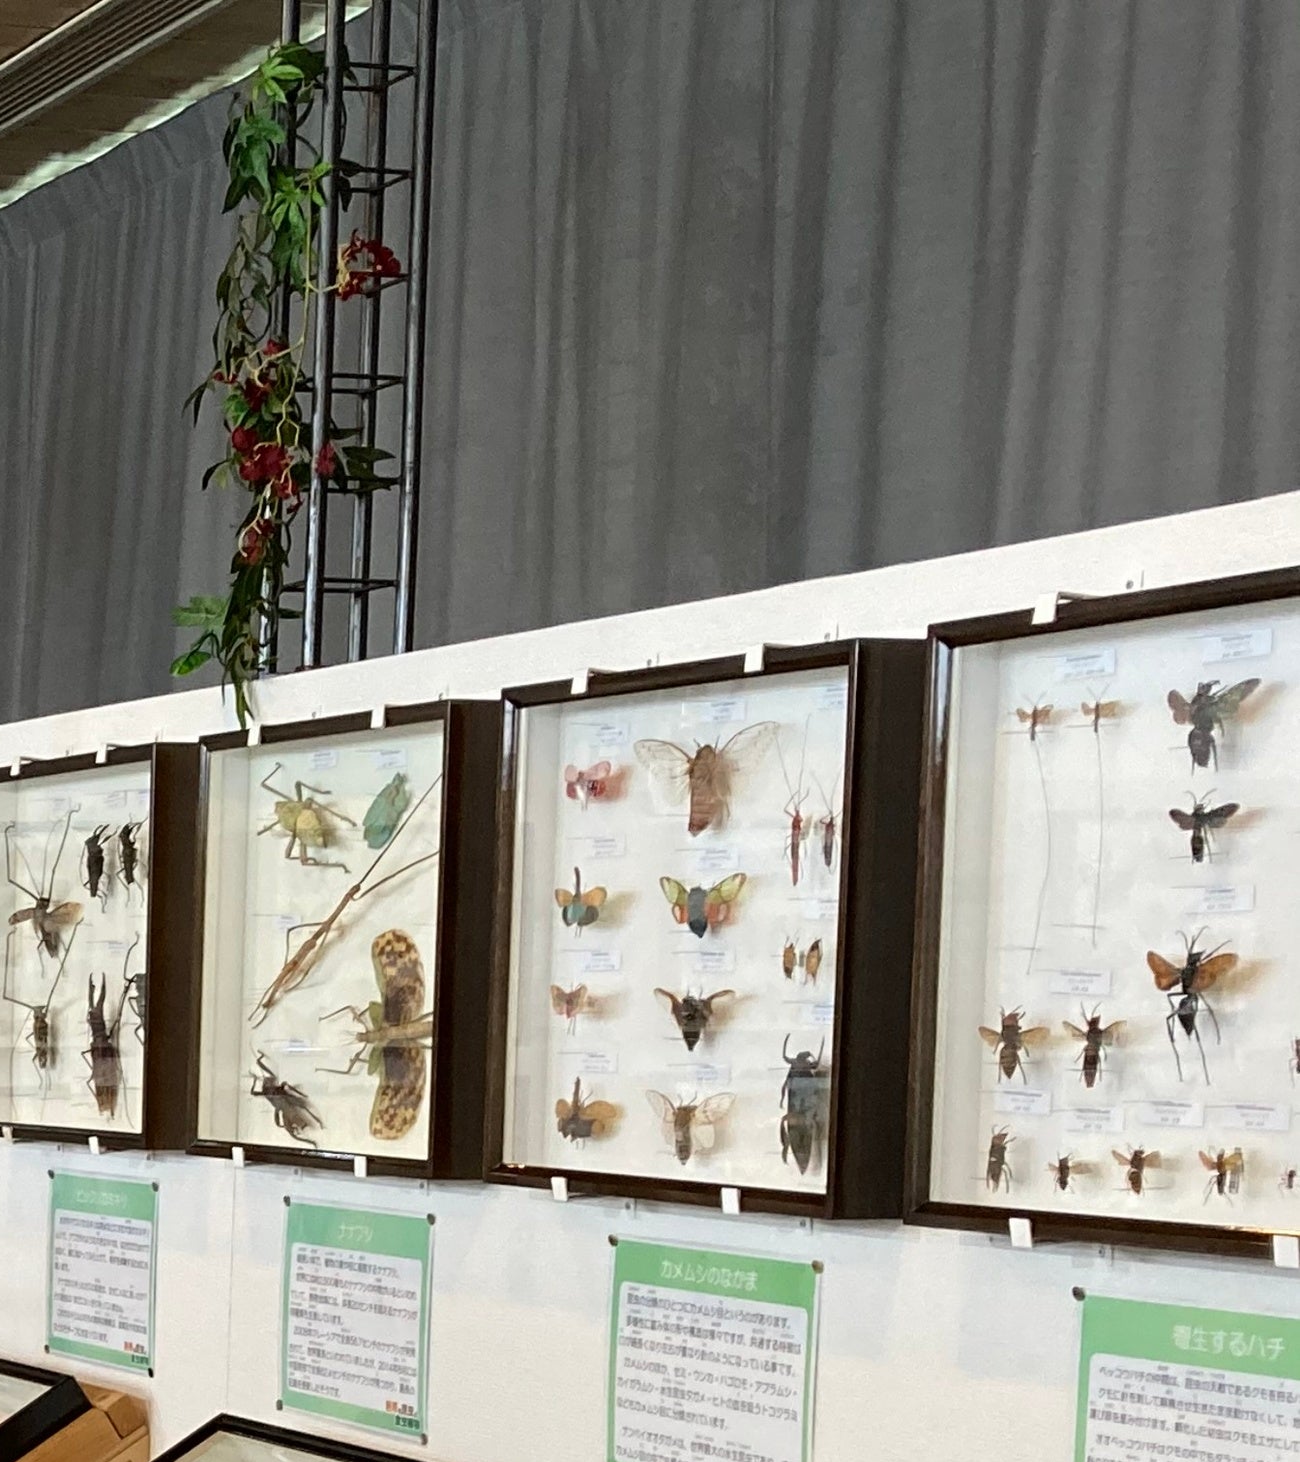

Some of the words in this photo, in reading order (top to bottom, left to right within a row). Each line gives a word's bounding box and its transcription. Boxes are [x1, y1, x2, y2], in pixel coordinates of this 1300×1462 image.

[660, 1260, 758, 1291] カメムシのなかま
